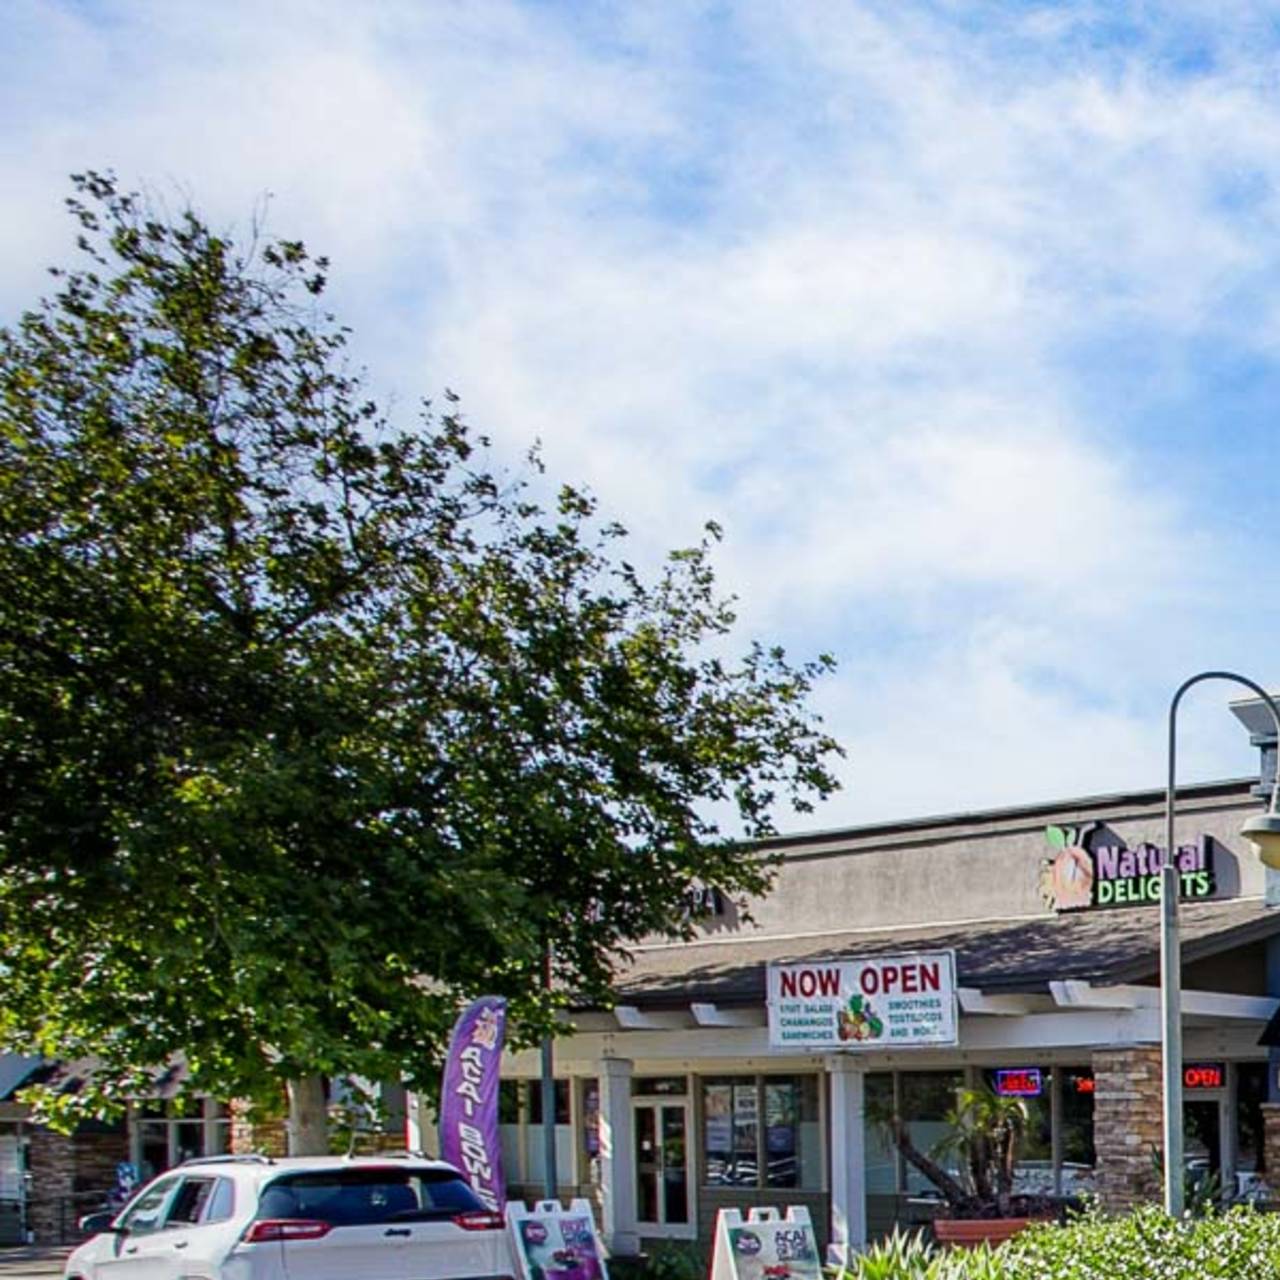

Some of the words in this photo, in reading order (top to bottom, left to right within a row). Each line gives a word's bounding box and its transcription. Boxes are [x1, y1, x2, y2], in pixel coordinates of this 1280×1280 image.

[1096, 831, 1205, 881] Natual
[1098, 871, 1210, 904] DELIGTS
[779, 968, 841, 998] NOW
[860, 963, 941, 996] OPEN
[1184, 1066, 1221, 1088] OPEN
